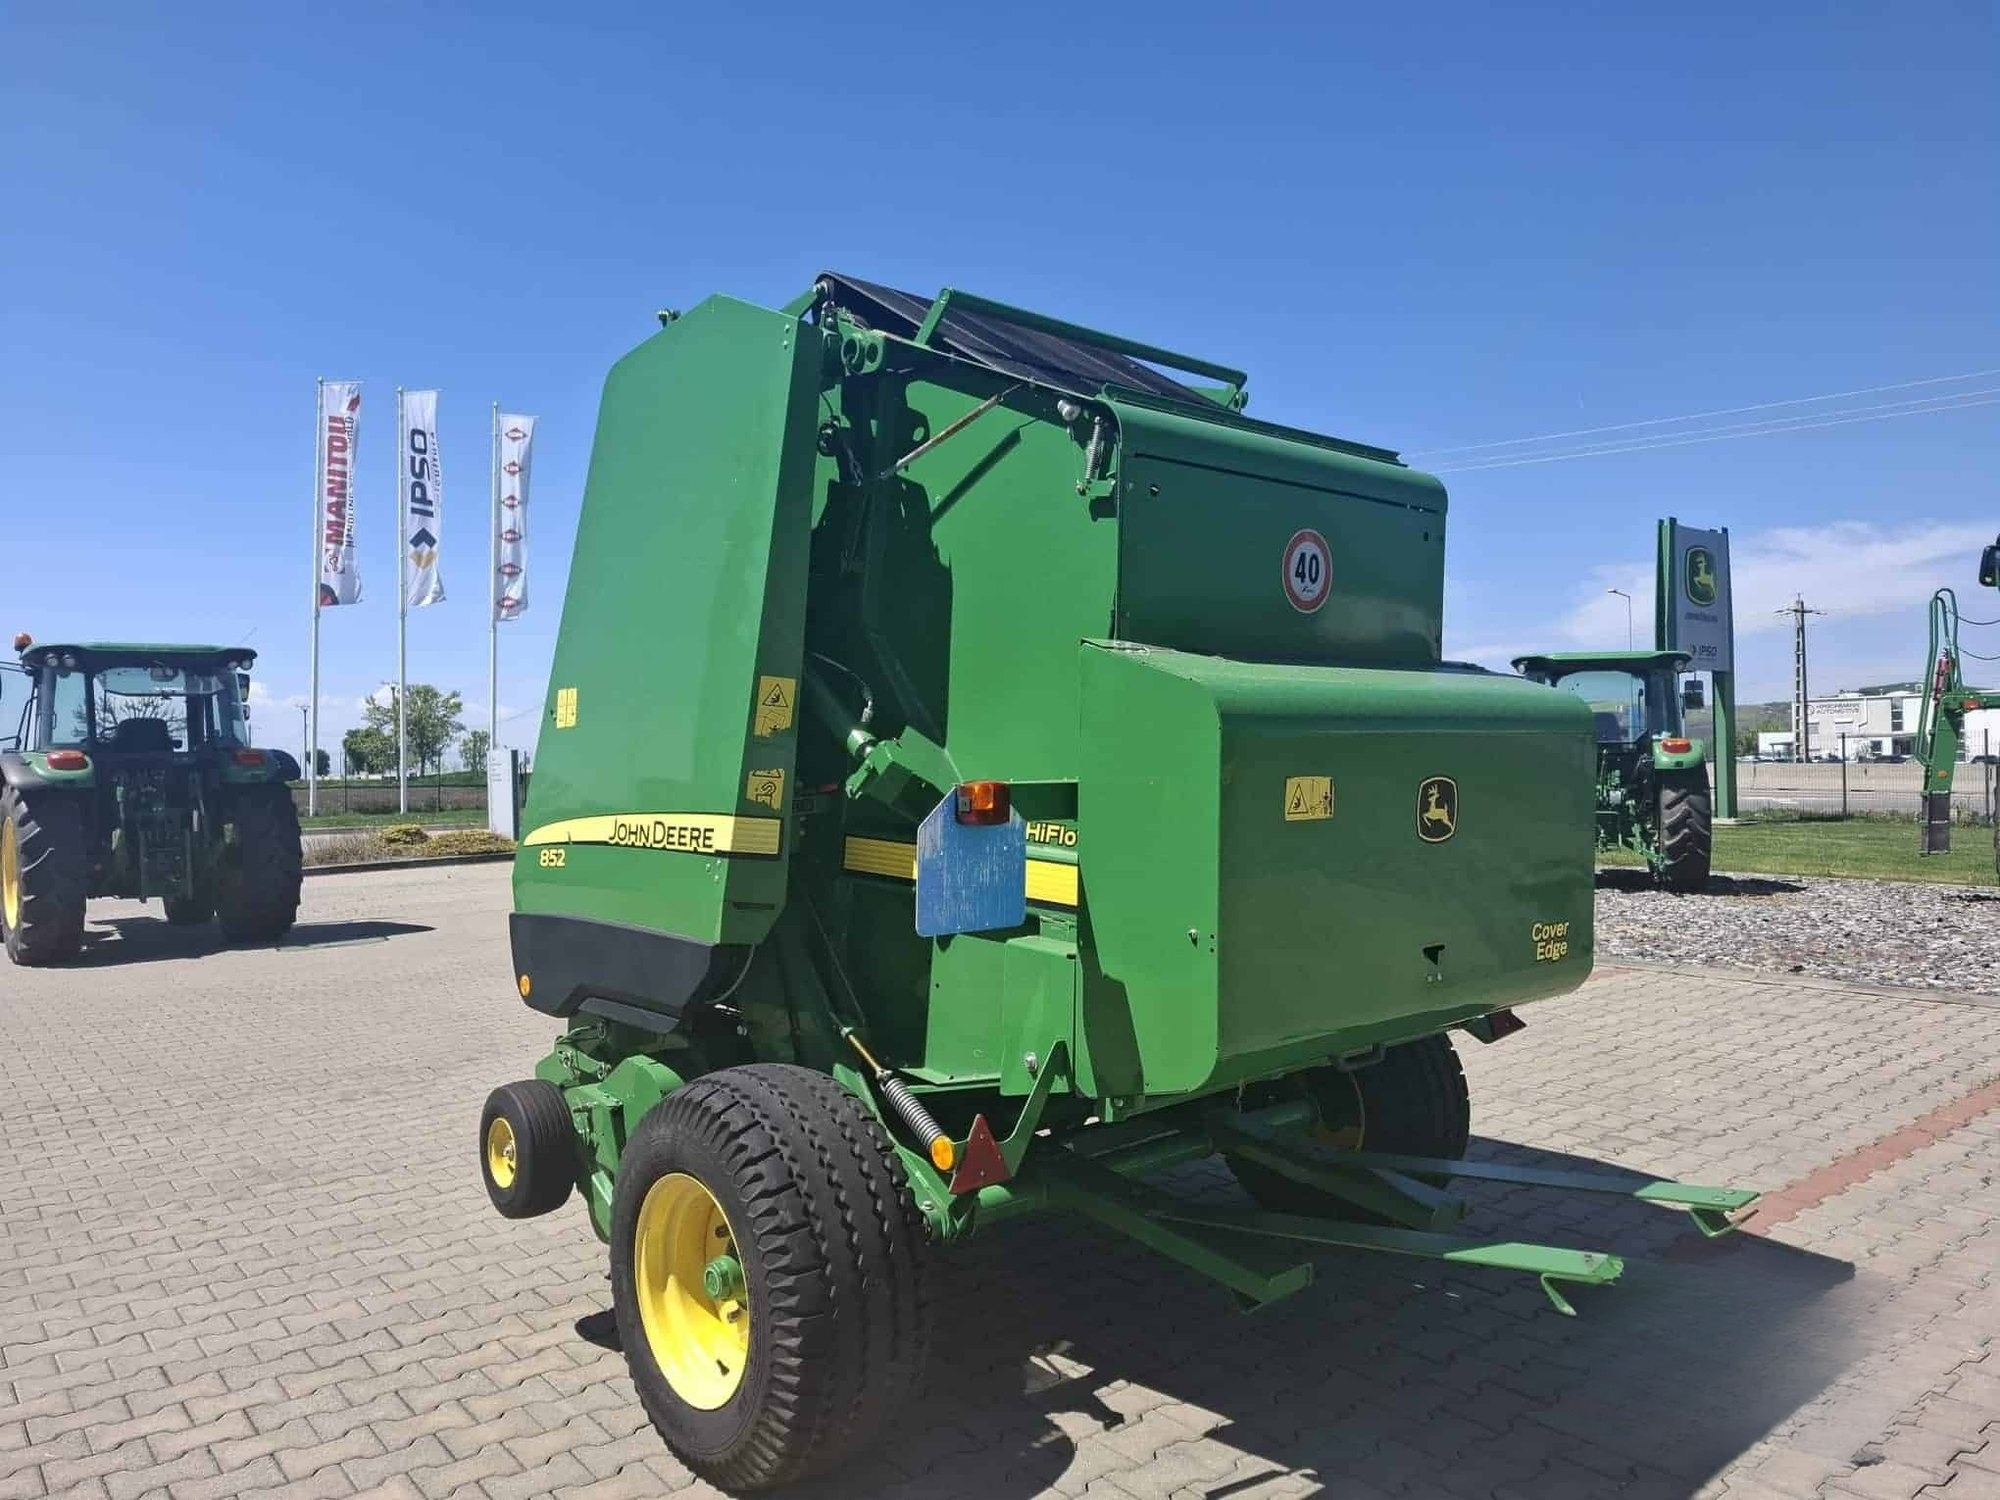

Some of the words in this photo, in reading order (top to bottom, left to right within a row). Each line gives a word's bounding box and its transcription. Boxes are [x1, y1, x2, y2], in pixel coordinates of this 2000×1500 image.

[325, 415, 348, 546] MANITOU
[409, 428, 435, 518] IPSO
[1294, 552, 1320, 585] 40
[608, 817, 651, 843] JOHN
[653, 820, 714, 849] DEERE
[1025, 821, 1078, 847] HiFlo
[539, 849, 566, 867] 852
[1531, 921, 1569, 942] Cover
[1536, 940, 1568, 961] Edge
